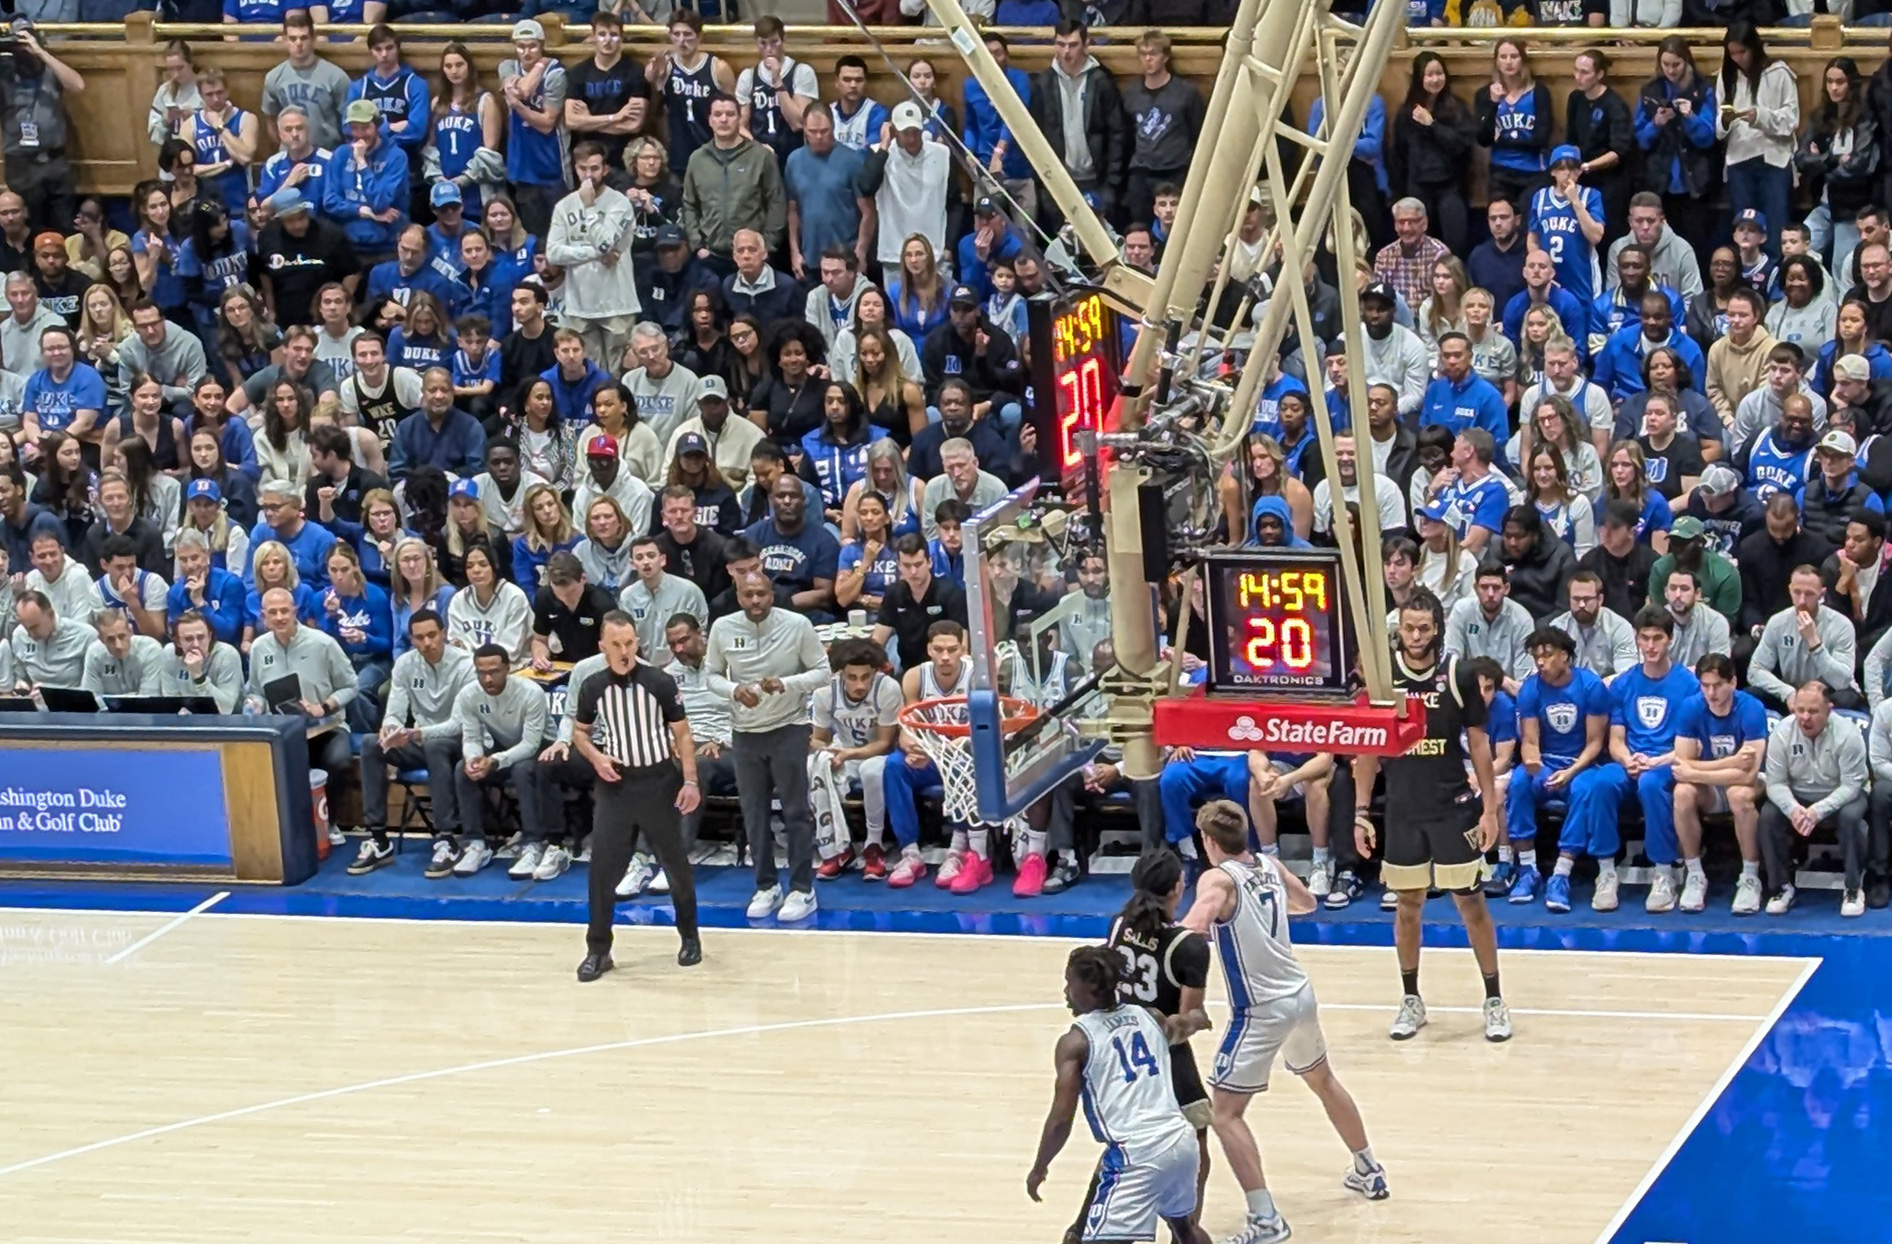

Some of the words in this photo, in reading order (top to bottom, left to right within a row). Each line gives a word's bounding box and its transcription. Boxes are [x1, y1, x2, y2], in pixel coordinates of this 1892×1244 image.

[672, 76, 710, 98] Duke
[437, 116, 475, 133] DUKE
[1496, 114, 1535, 131] UKE
[450, 132, 458, 155] 1
[1541, 217, 1578, 234] DUKE
[1549, 236, 1563, 262] 2
[404, 346, 440, 361] DUKE
[1756, 466, 1797, 488] DUKE
[1239, 573, 1327, 611] 14:59
[1247, 618, 1312, 668] 20
[1234, 674, 1324, 686] DAKTRONICS
[1266, 718, 1388, 748] StateFarm
[79, 789, 126, 808] Duke
[17, 812, 35, 832] &
[36, 811, 75, 832] Golf
[1257, 891, 1278, 938] 7
[1112, 1031, 1159, 1083] 14
